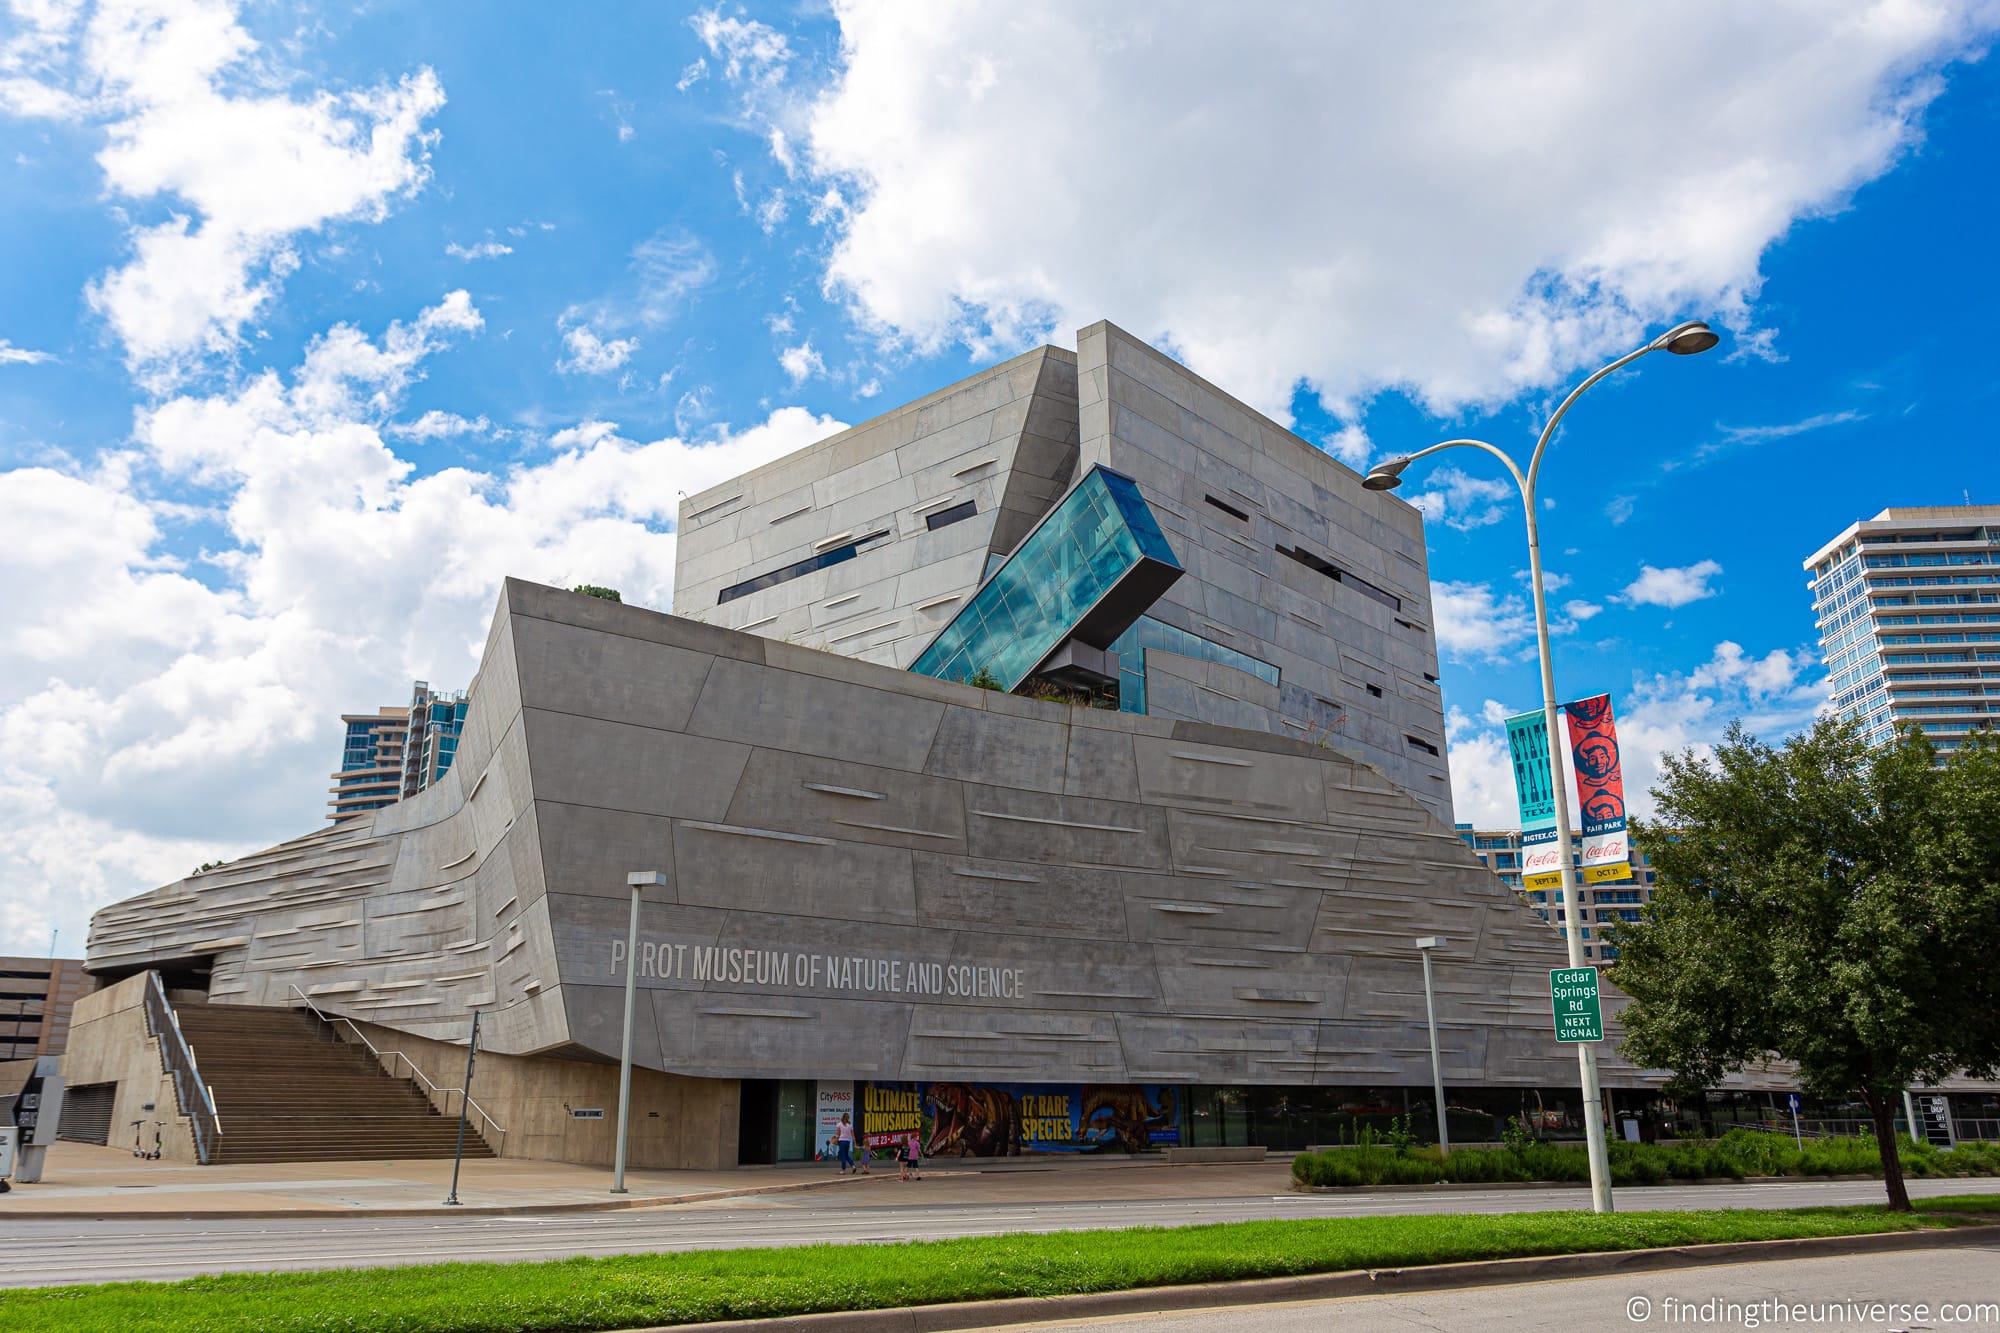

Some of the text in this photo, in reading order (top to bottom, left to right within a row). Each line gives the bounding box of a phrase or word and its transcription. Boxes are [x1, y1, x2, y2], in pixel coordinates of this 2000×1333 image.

[1523, 806, 1555, 817] TEXA
[1587, 820, 1622, 833] FAIR PARK
[1523, 831, 1558, 843] BIGTEX.CO
[1534, 878, 1548, 886] SEPT
[610, 939, 1024, 1000] PROT MUSEUM OF NATURE AND SCIENCE
[1557, 972, 1590, 984] Cedar
[1554, 986, 1596, 1000] Springs
[1569, 1000, 1583, 1011] Rd
[1564, 1017, 1590, 1027] NEXT
[1560, 1028, 1599, 1038] SIGNAL
[820, 1092, 851, 1102] CityPASS
[864, 1087, 920, 1112] ULTIMATE
[1022, 1095, 1069, 1116] 17 RARE
[864, 1112, 921, 1133] DINOSAURS
[1022, 1118, 1072, 1141] SPECIES
